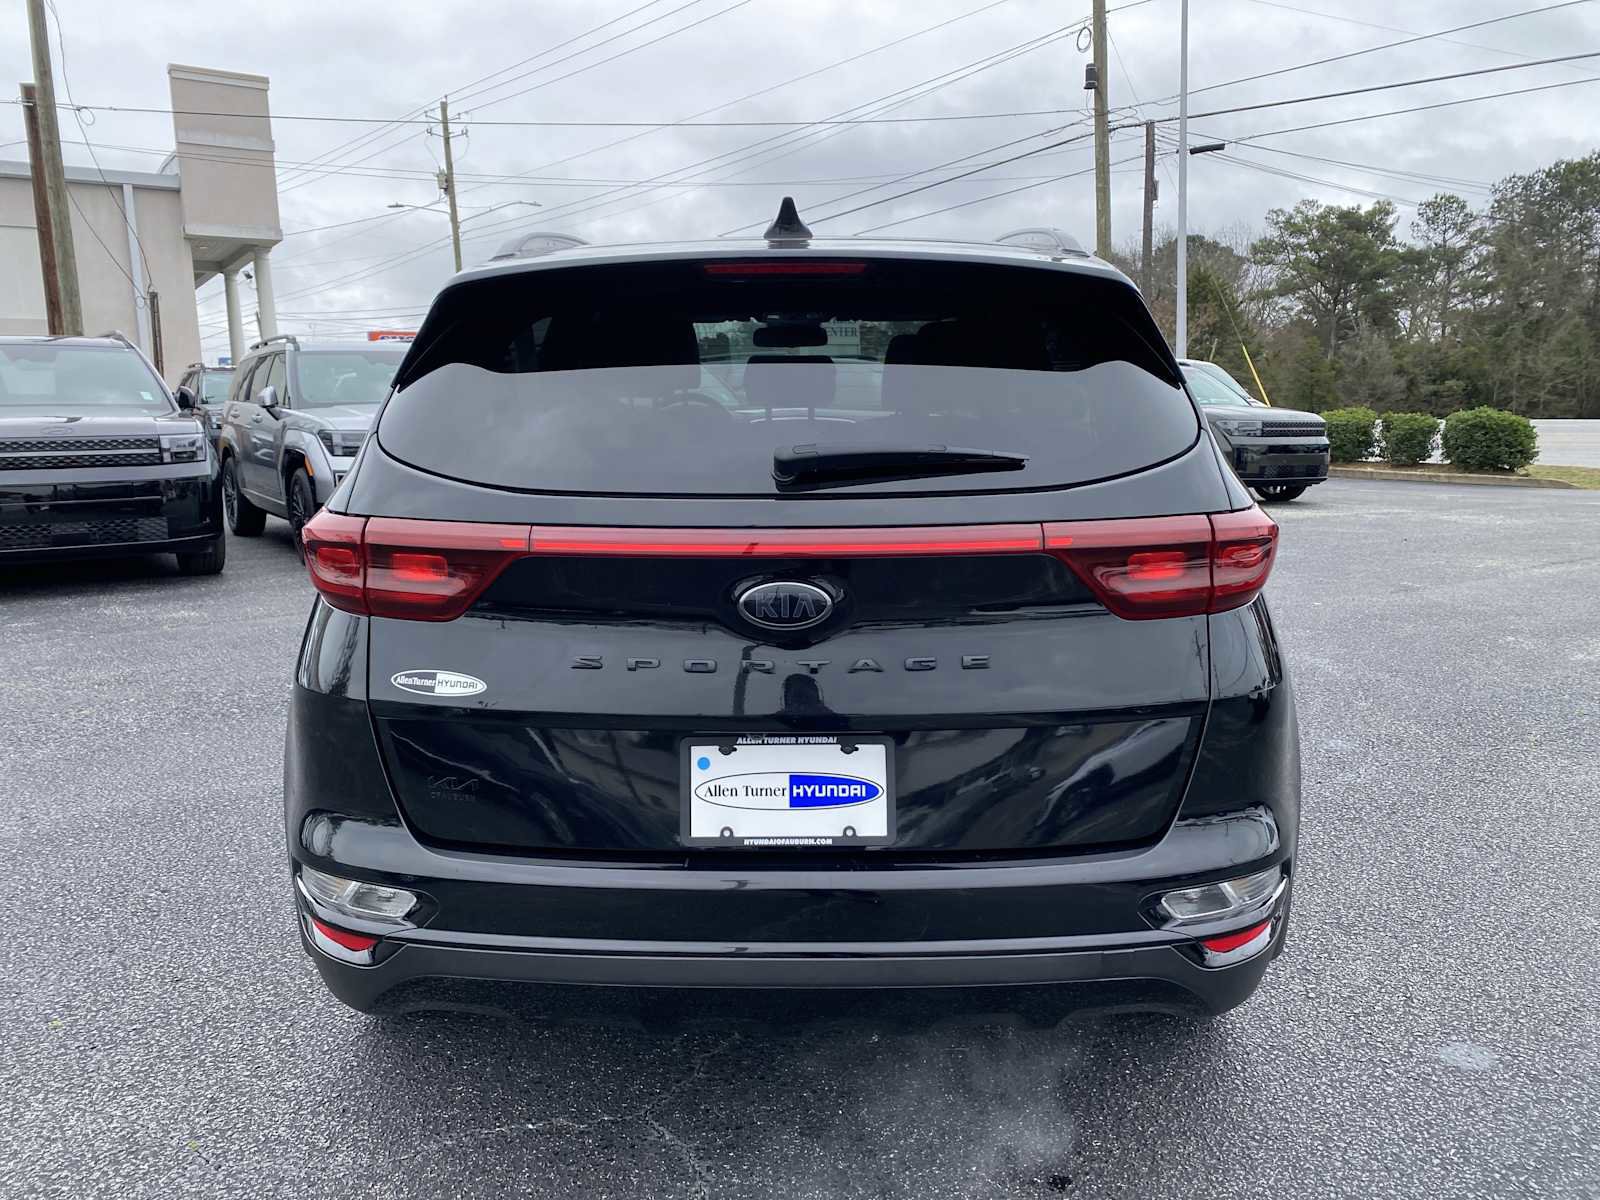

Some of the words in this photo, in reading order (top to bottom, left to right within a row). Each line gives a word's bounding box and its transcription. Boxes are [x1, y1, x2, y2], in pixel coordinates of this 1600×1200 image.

[754, 592, 817, 618] KIA
[571, 654, 991, 675] SPORTAGE
[437, 679, 478, 689] HYUNDAI
[763, 736, 796, 744] TURNER
[797, 736, 837, 744] HYUNDAI
[703, 784, 738, 798] Allen
[742, 784, 787, 798] Turner
[792, 784, 867, 798] HYUNDAI
[743, 838, 833, 846] HYUNDAIOFAUBURN.COM
